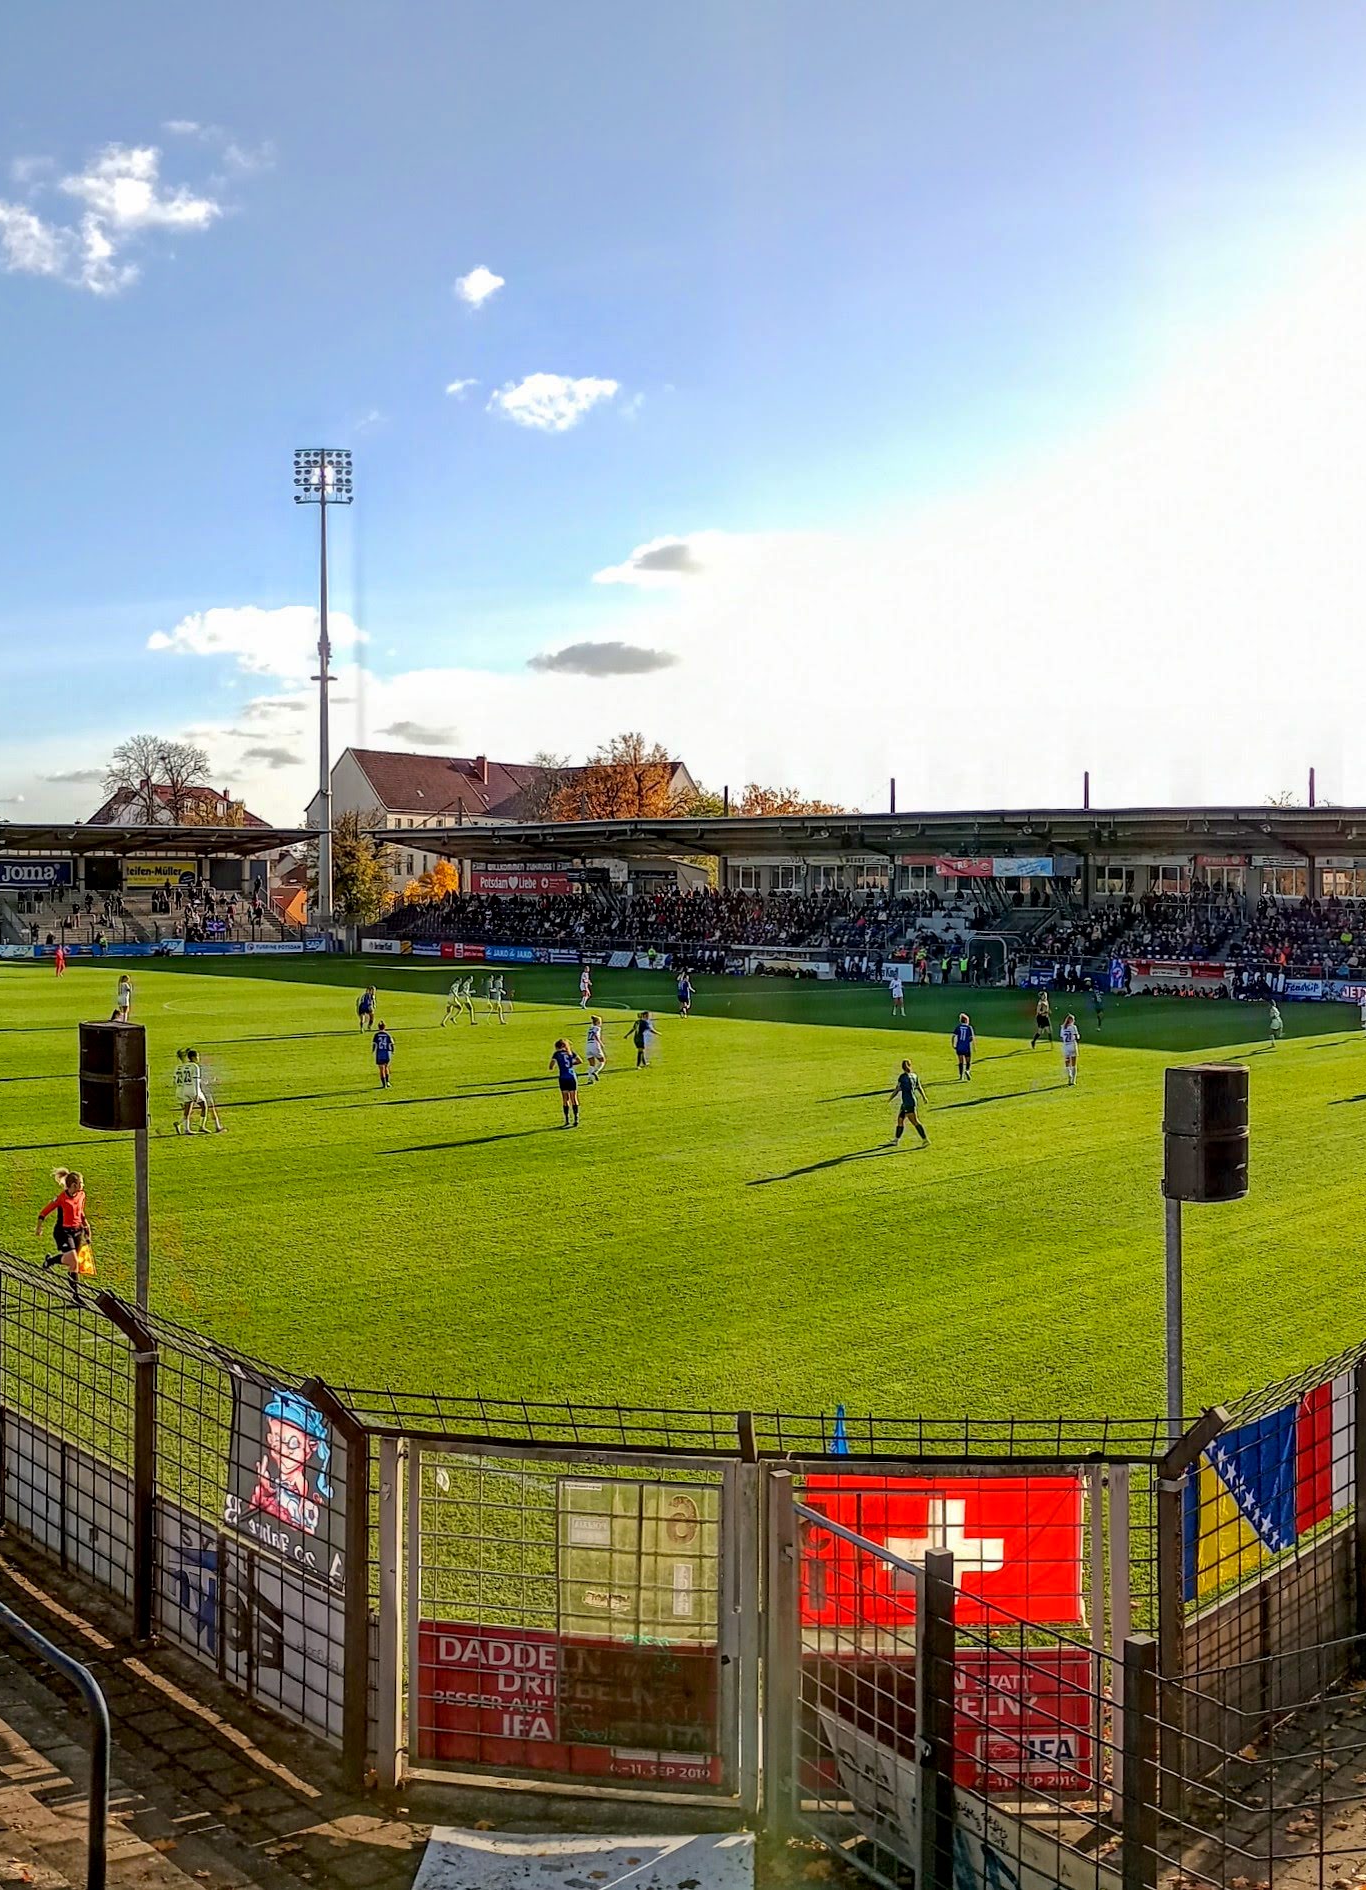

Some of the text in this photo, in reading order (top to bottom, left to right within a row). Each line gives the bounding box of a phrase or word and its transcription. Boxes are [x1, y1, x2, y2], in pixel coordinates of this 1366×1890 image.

[480, 876, 537, 889] Potsdam Liebe
[305, 941, 320, 949] SAP
[378, 1037, 387, 1050] 24
[563, 1055, 570, 1067] 5
[438, 1637, 602, 1676] DADDELN
[434, 1690, 503, 1709] BESSER
[510, 1697, 549, 1712] AUF
[501, 1713, 554, 1740] IFA
[1028, 1739, 1075, 1761] IFA
[650, 1766, 676, 1776] SEP
[678, 1767, 711, 1779] 2019
